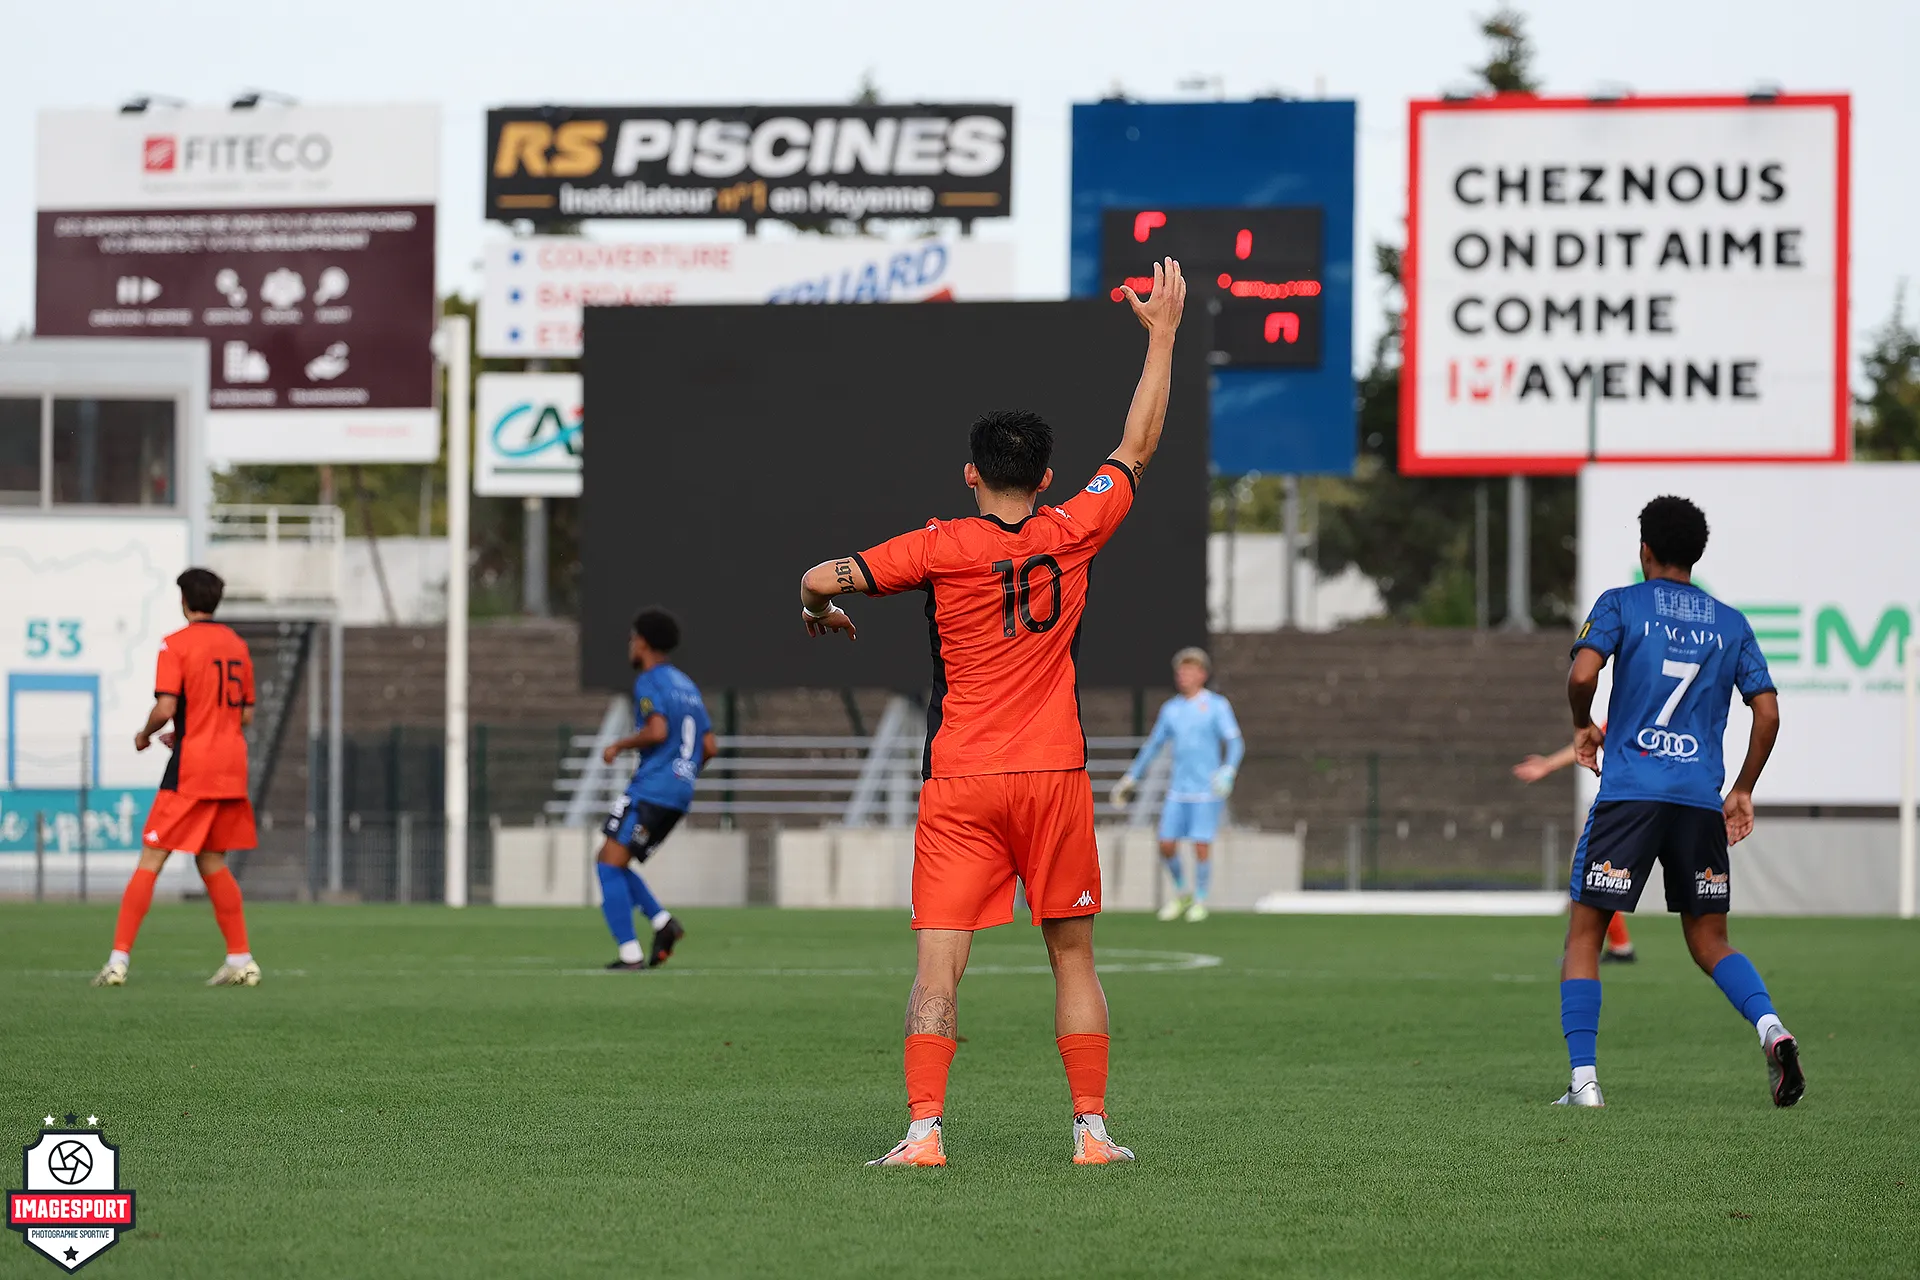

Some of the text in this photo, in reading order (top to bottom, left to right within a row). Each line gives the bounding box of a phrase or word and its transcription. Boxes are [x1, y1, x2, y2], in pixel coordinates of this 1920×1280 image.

[184, 134, 333, 172] FITECO
[494, 116, 1006, 178] RS PISCINES
[559, 181, 716, 214] Installateur
[769, 186, 808, 214] en
[809, 182, 934, 219] Mayenne
[1453, 163, 1786, 204] CHEZ NOUS
[538, 244, 731, 270] COUVERTURE
[1453, 229, 1804, 270] ON DIT AIME
[1453, 296, 1676, 335] COMME
[992, 554, 1062, 637] 10
[24, 617, 84, 658] 53
[213, 660, 243, 707] 15
[1655, 659, 1700, 727] 7
[1586, 871, 1631, 890] d'Erwan
